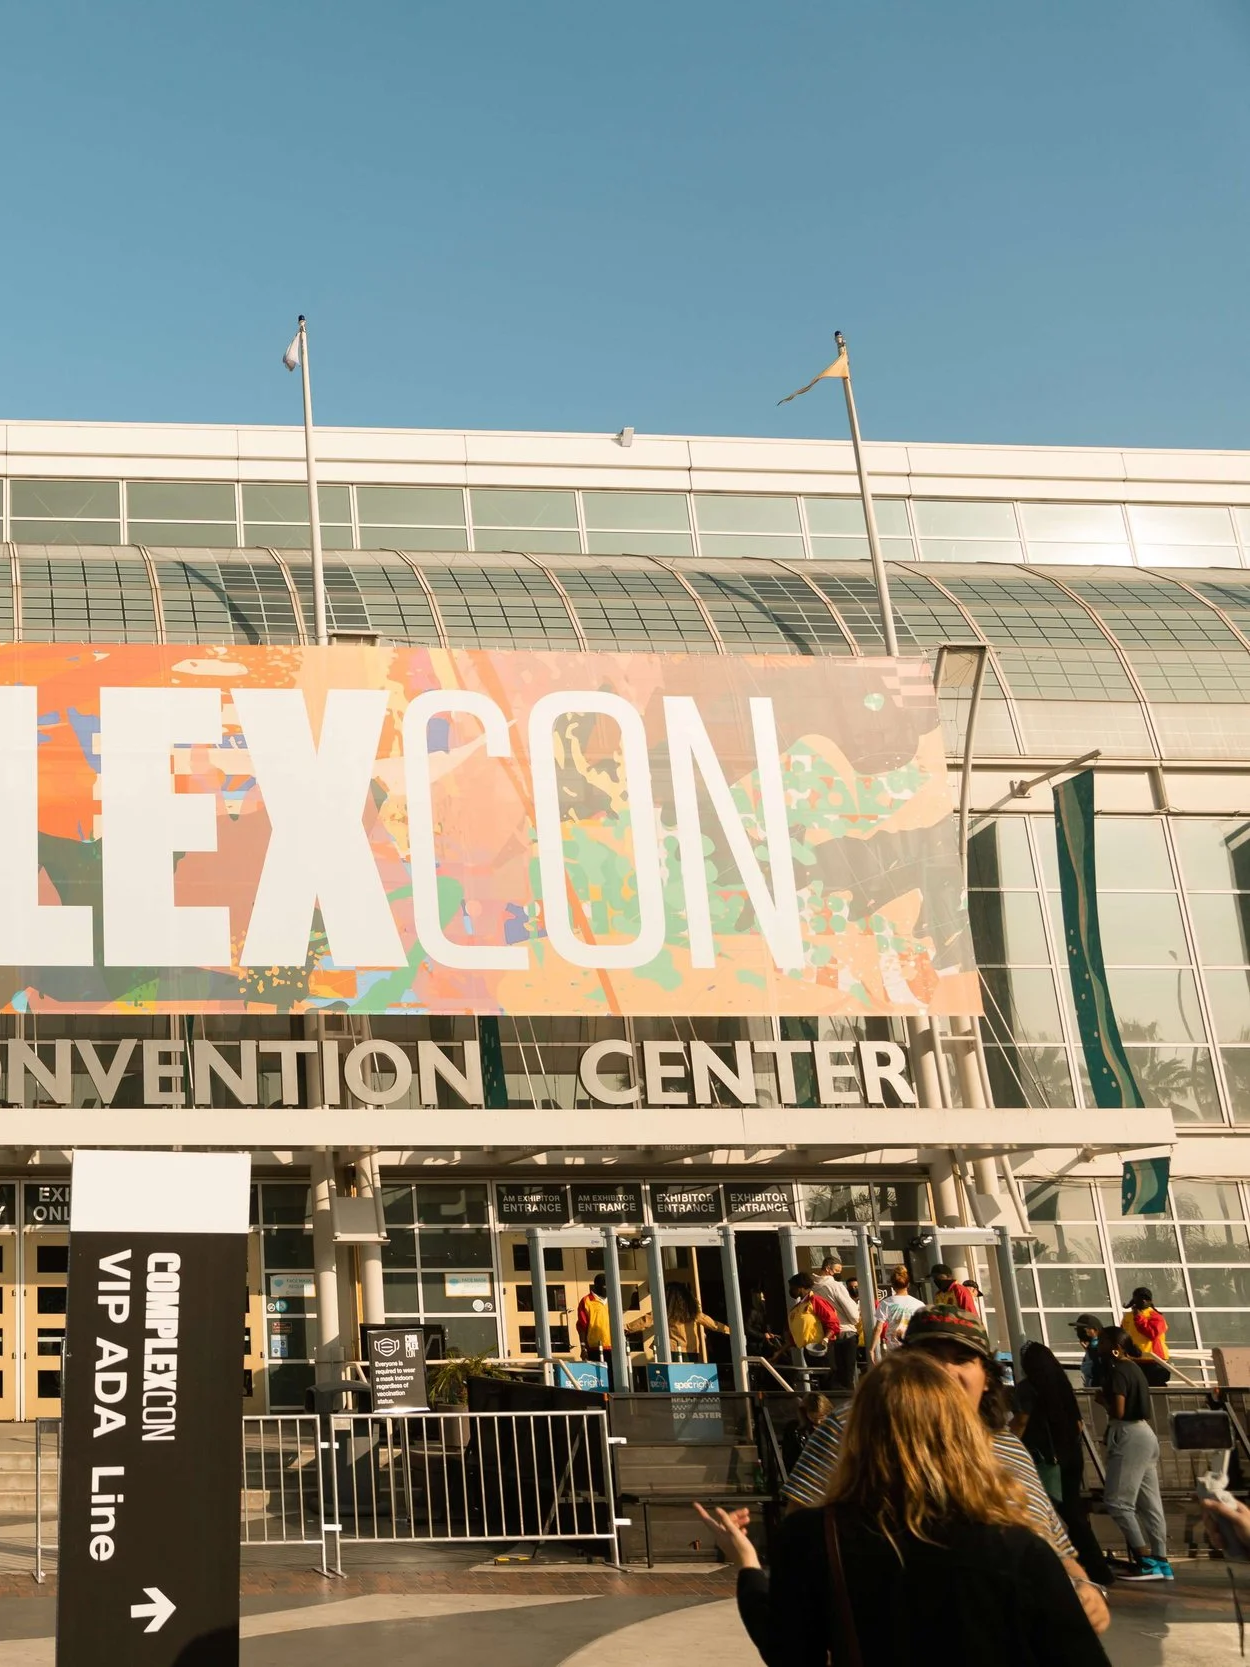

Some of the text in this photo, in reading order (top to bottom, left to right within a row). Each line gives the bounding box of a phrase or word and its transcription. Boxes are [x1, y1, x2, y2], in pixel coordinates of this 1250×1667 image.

[579, 1039, 920, 1106] CENTER
[39, 1187, 71, 1202] EXI
[656, 1193, 714, 1203] EXHIBITOR
[730, 1193, 788, 1203] EXHIBITOR
[503, 1203, 562, 1212] ENTRANCE
[577, 1203, 637, 1212] ENTRANCE
[657, 1203, 716, 1213] ENTRANCE
[731, 1203, 789, 1213] ENTRANCE
[33, 1205, 71, 1221] ONL
[141, 1252, 182, 1441] COMPLEXCON
[374, 1360, 398, 1368] Everyone
[89, 1248, 132, 1562] VIP ADA Line
[692, 1411, 722, 1419] ASTER
